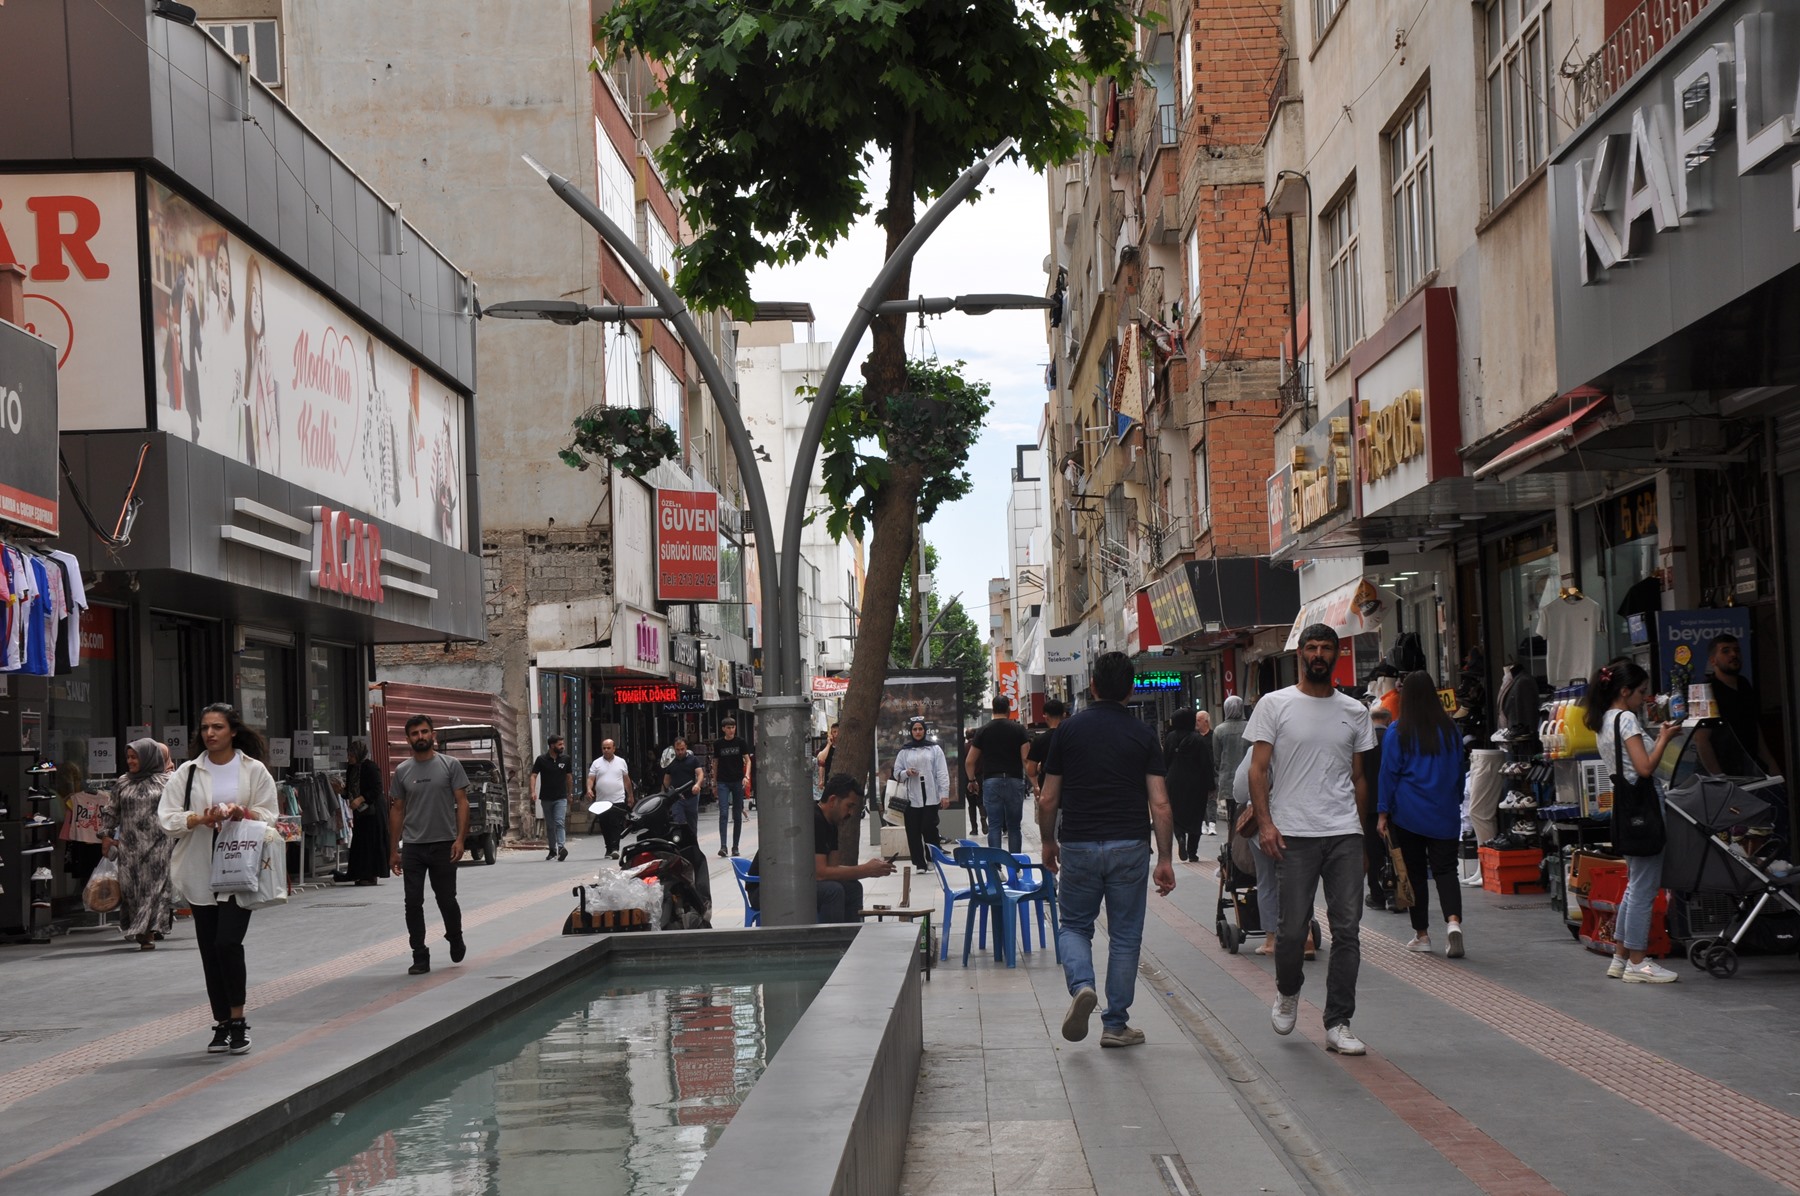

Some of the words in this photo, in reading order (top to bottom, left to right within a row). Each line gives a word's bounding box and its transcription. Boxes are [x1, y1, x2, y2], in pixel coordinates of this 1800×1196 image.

[1575, 12, 1800, 287] KAPL
[297, 399, 337, 474] Kalbi
[662, 503, 716, 532] GÜVEN
[311, 505, 384, 604] ACAR
[661, 541, 691, 560] SÜRÜCÜ
[692, 544, 717, 562] KURSU
[662, 573, 677, 586] Tel:
[695, 573, 705, 587] 24
[707, 574, 716, 587] 24
[1668, 625, 1744, 645] beyazsu
[616, 686, 647, 703] TOMBİK
[649, 685, 677, 701] DÖNER
[216, 840, 258, 852] ANBAR
[224, 852, 242, 860] GYM
